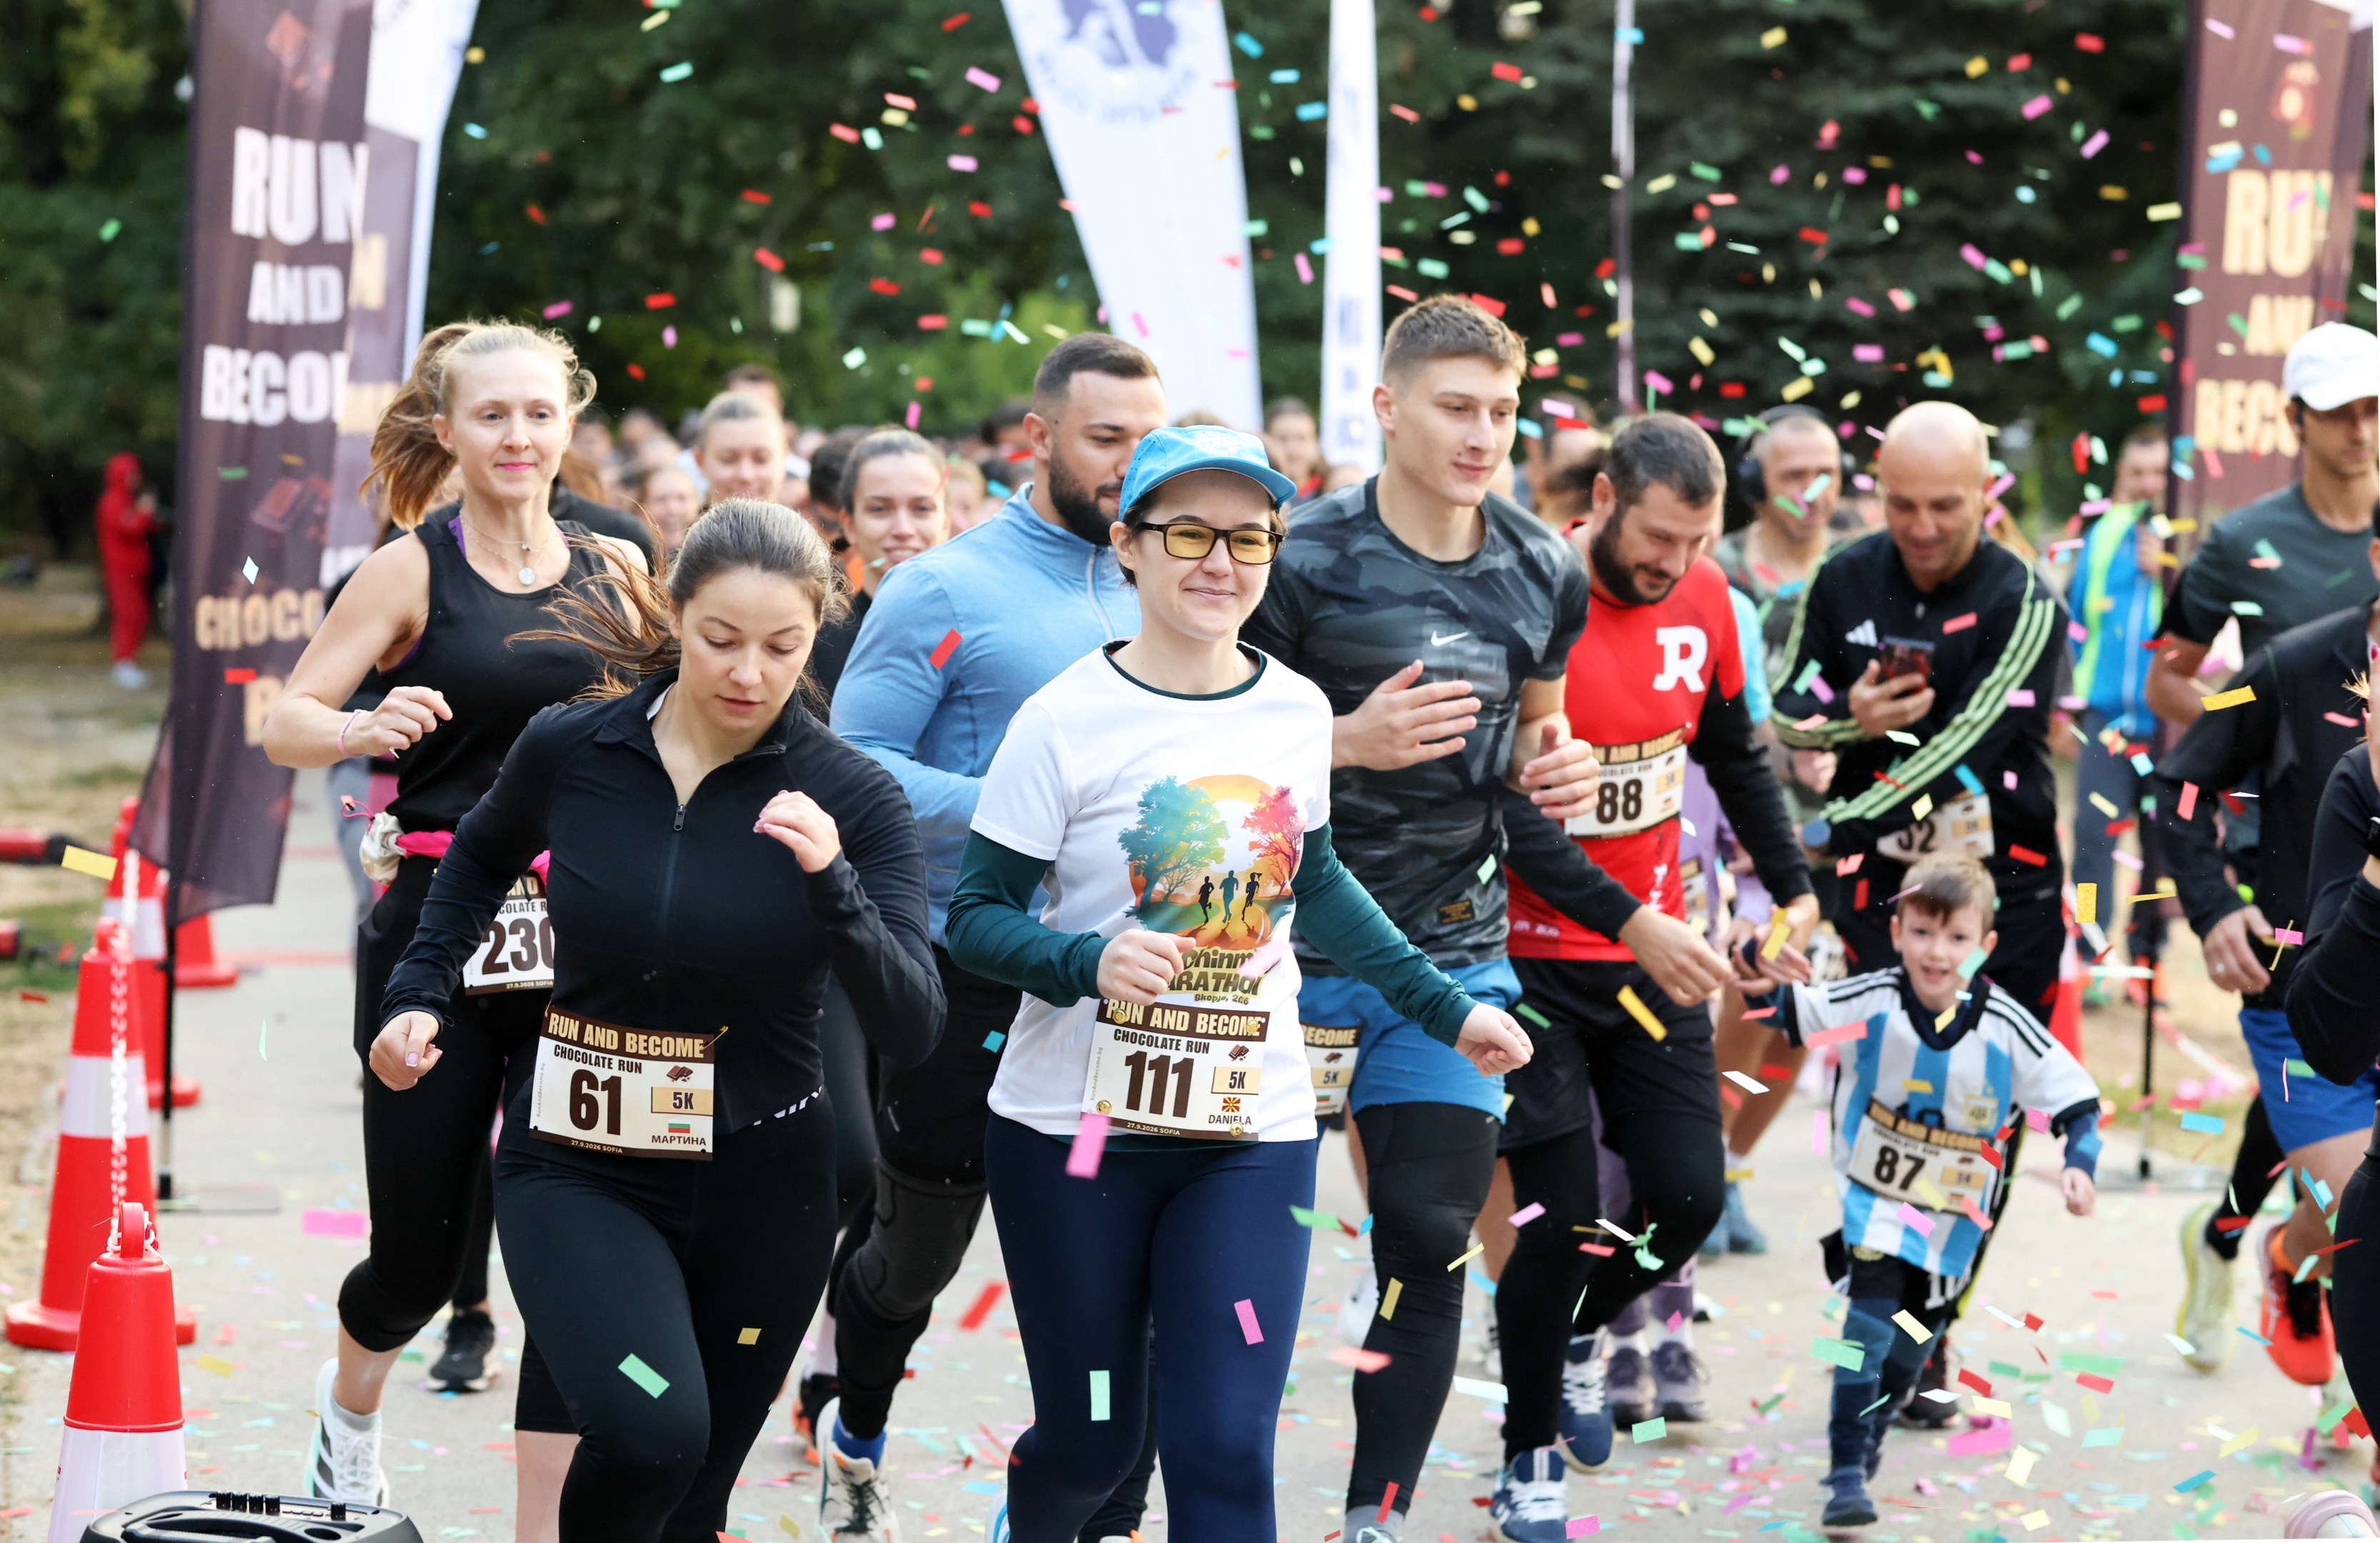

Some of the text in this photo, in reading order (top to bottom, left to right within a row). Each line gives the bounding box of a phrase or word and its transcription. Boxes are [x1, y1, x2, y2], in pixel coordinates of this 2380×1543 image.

[231, 126, 369, 246] RUN
[247, 261, 344, 326] AND
[1652, 625, 1708, 693] R
[1596, 779, 1642, 824] 88
[481, 917, 555, 976] 230
[548, 1013, 704, 1058] RUN AND BECOME
[1106, 1000, 1144, 1025] RUN
[1150, 1007, 1190, 1032] AND
[554, 1044, 642, 1074] CHOCOLATE RUN
[1113, 1029, 1210, 1054] CHOCOLATE RUN
[537, 1062, 546, 1118] RunAndBecome.bg
[1090, 1047, 1103, 1101] RunAndBecome.bg
[1125, 1050, 1194, 1119] 111
[1228, 1072, 1246, 1089] 5K
[1323, 1071, 1340, 1084] 5K
[569, 1069, 622, 1136] 61
[672, 1092, 694, 1110] 5K
[1208, 1114, 1252, 1125] DANIELA
[571, 1139, 623, 1154] 27.9.2026 SOFIA
[651, 1135, 707, 1146] МАРТИНА
[1127, 1122, 1180, 1136] 27.9.2026 SOFIA
[1874, 1144, 1926, 1191] 87
